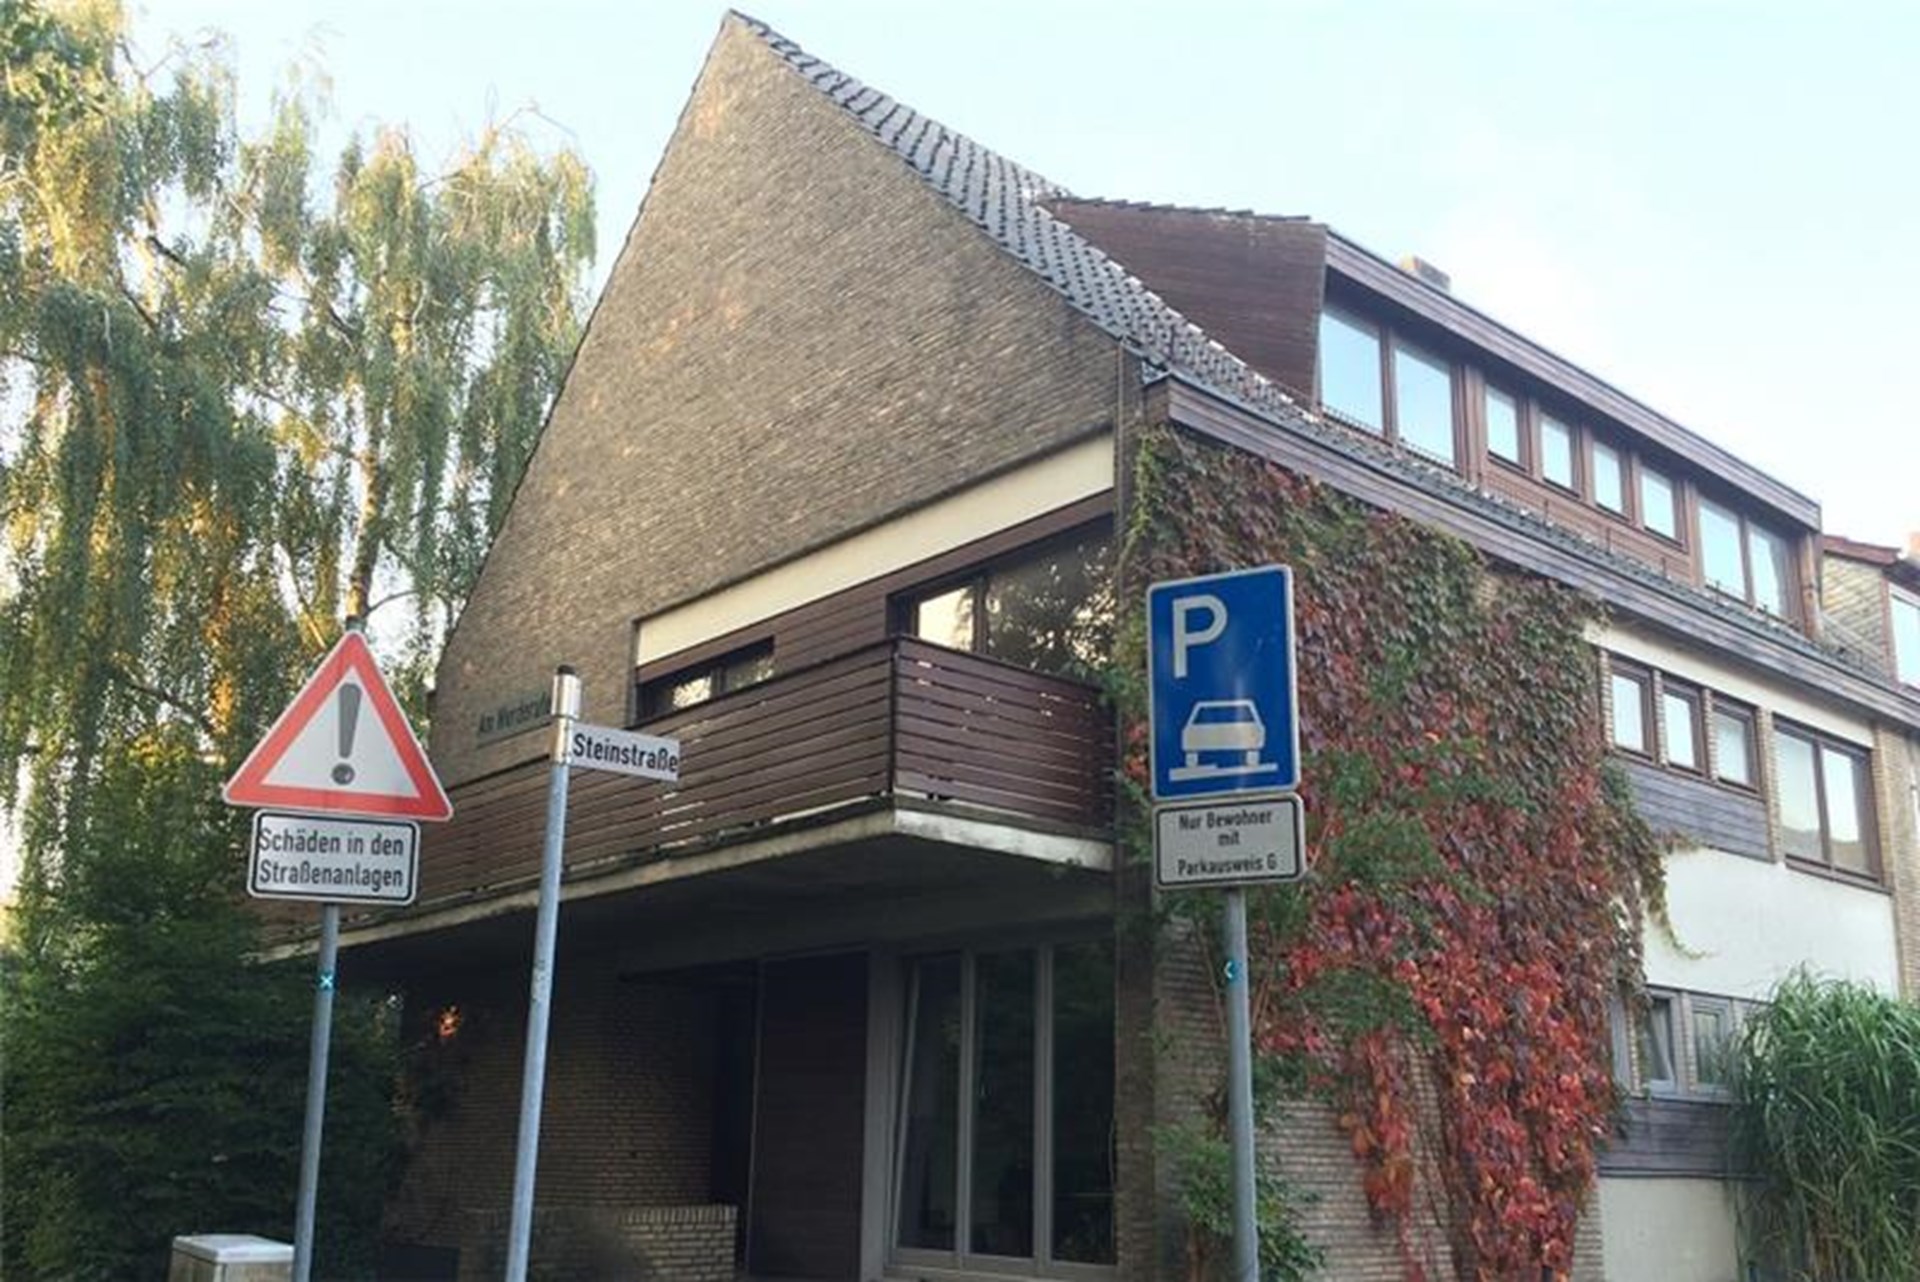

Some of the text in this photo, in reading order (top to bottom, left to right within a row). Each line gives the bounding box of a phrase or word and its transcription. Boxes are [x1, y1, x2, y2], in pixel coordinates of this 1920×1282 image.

[1173, 595, 1228, 678] P
[572, 733, 678, 773] Steinstraße
[1179, 809, 1273, 830] Nur Bewohner
[259, 828, 404, 856] Schäden in den
[1218, 831, 1240, 847] mit
[259, 858, 404, 892] Straßenanlagen
[1178, 857, 1263, 876] Parkausweis
